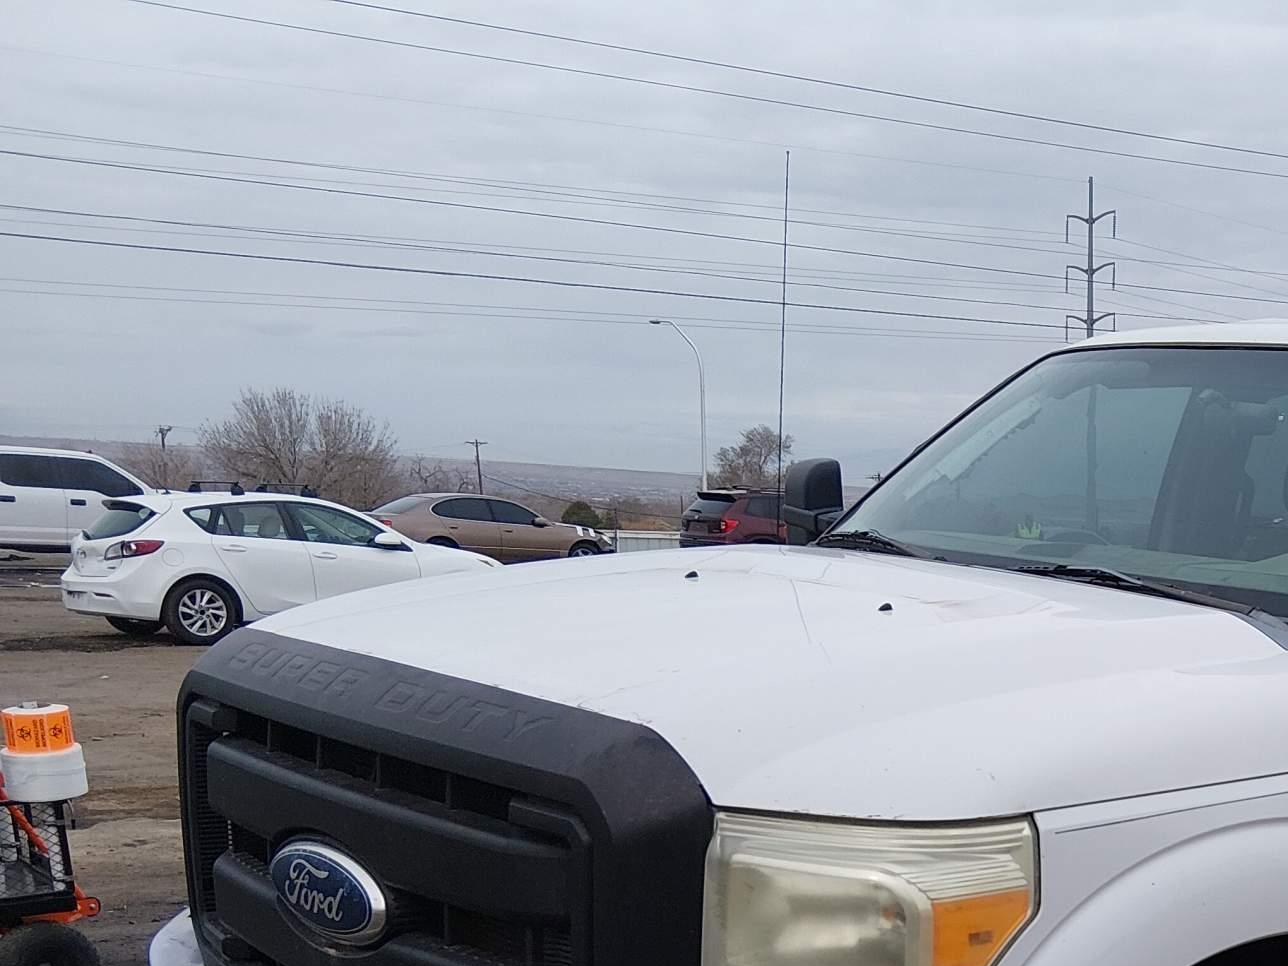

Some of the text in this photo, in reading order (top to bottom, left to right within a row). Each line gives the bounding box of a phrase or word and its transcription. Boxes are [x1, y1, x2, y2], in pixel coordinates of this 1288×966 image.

[230, 643, 553, 743] SUPER DUTY
[285, 858, 344, 921] Ford
